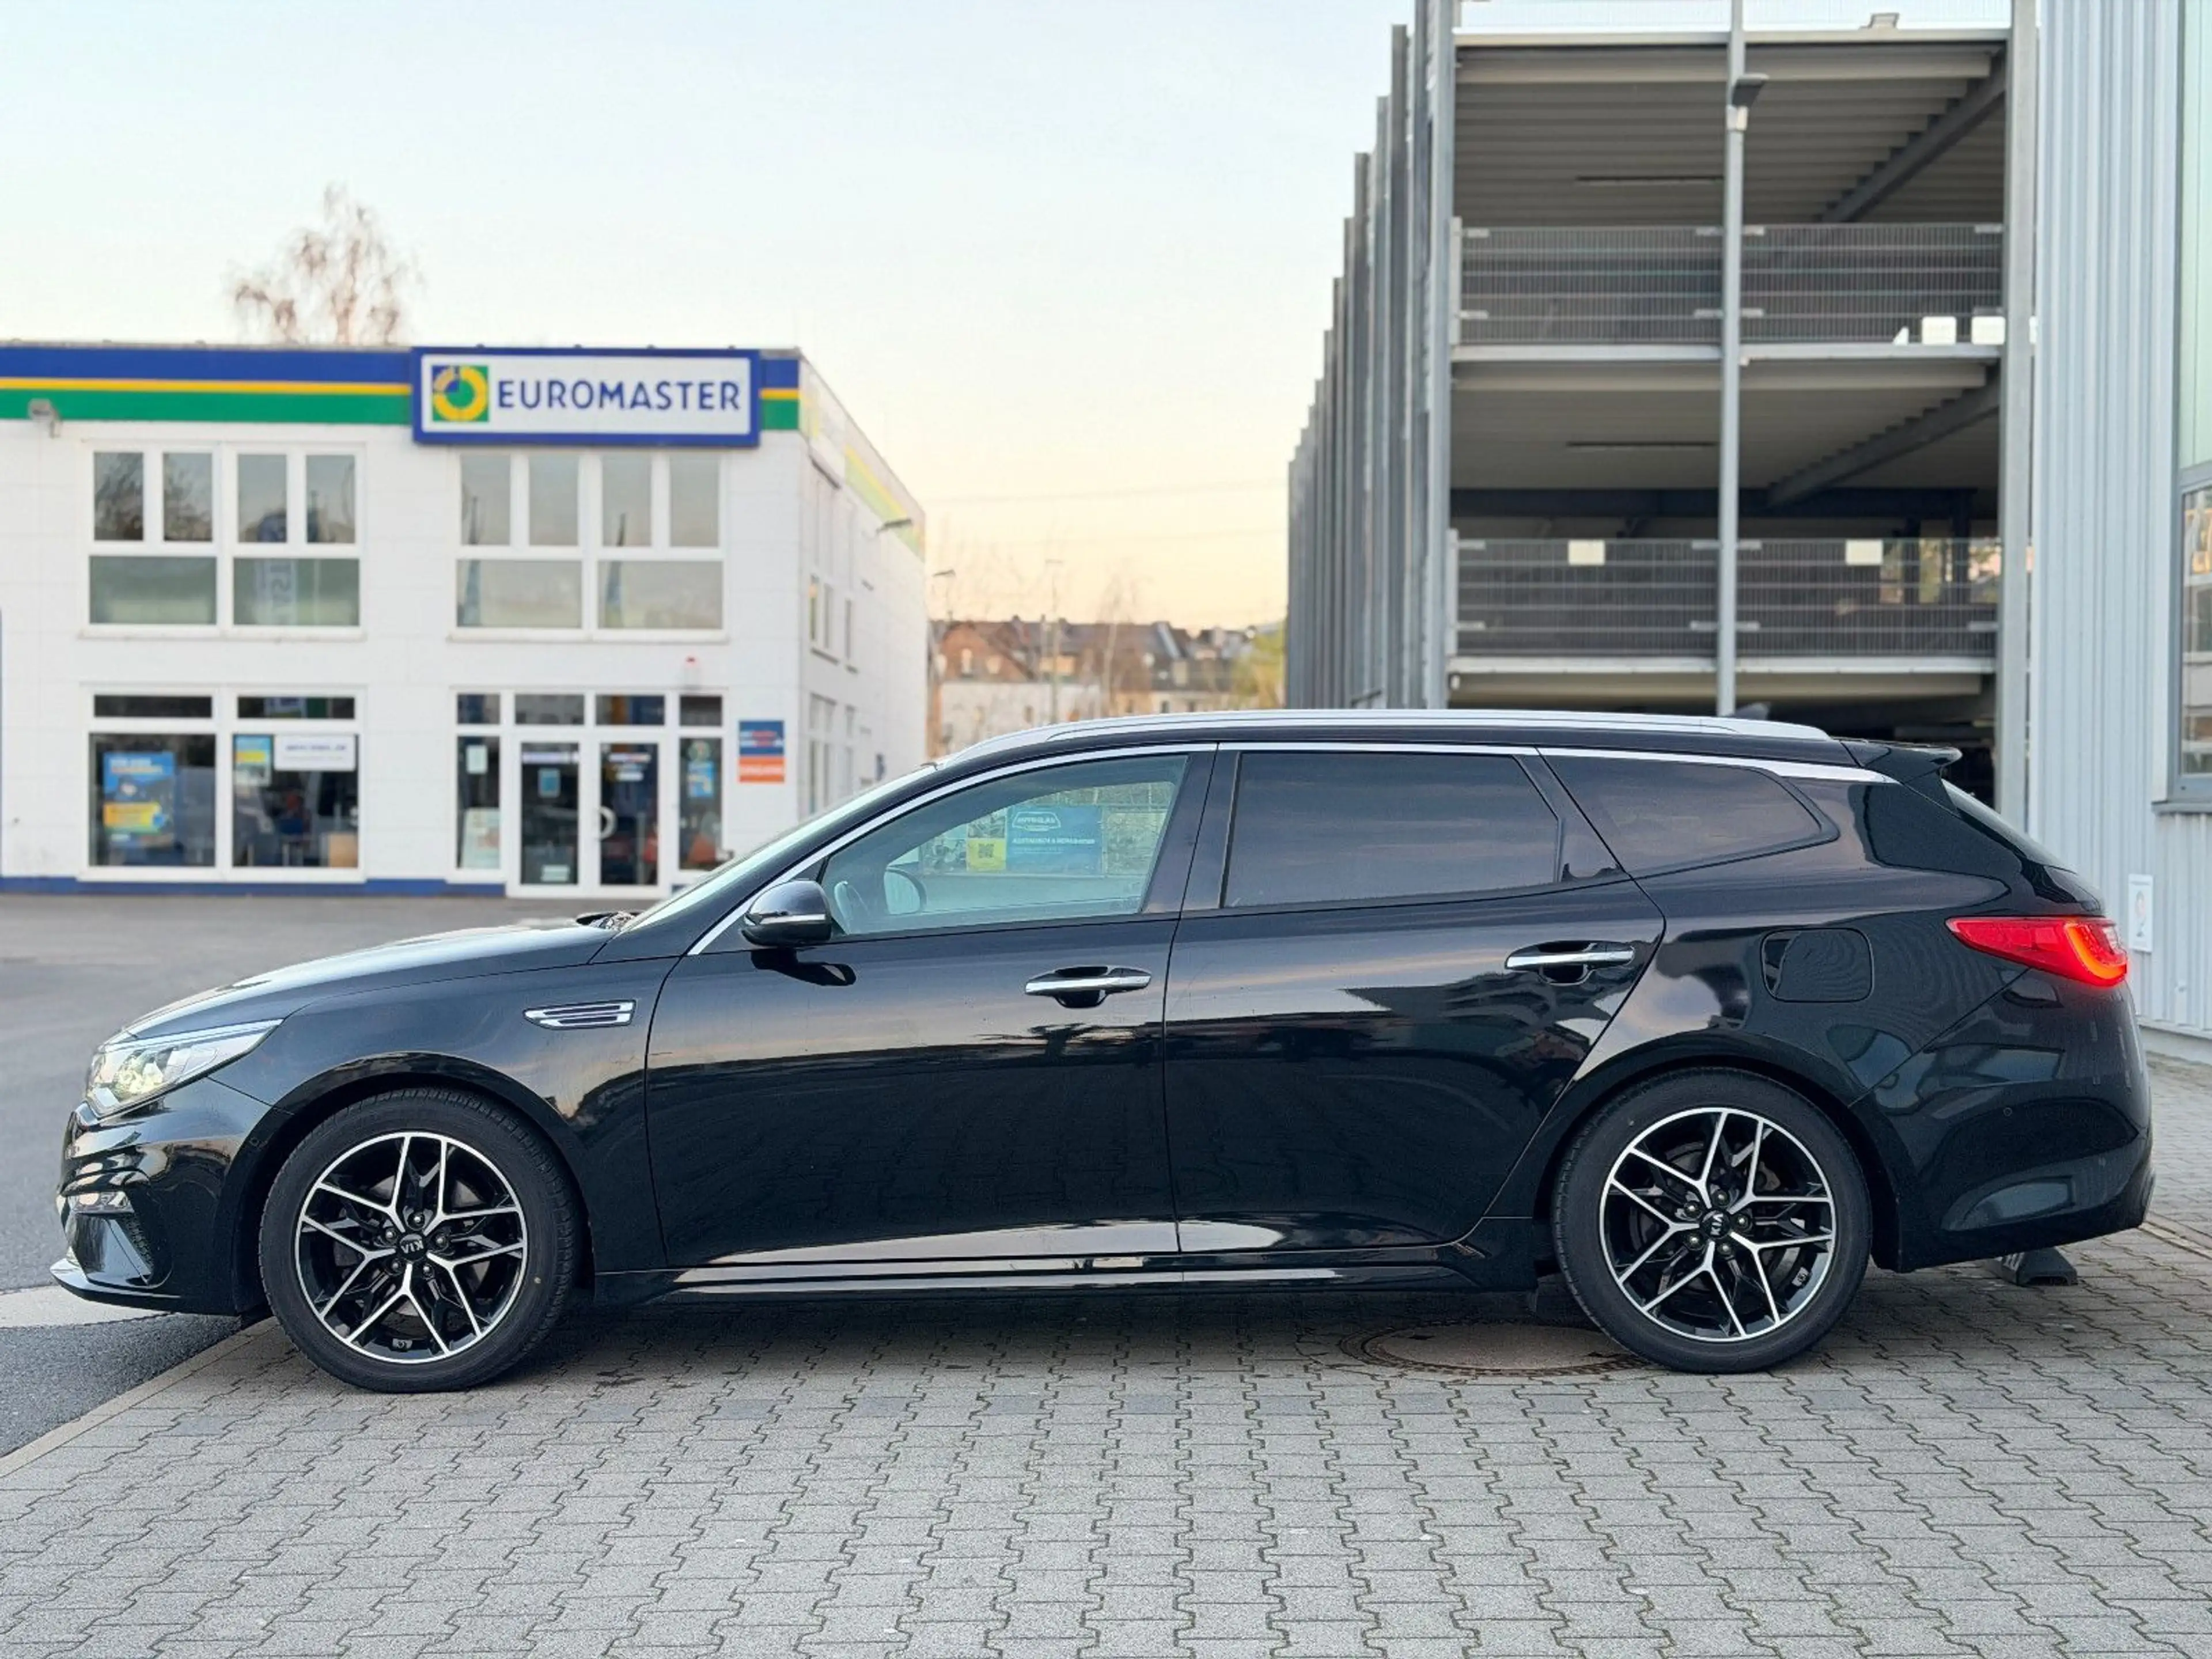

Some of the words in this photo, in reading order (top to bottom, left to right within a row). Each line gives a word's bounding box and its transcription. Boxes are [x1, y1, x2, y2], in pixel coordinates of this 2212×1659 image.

[498, 380, 740, 410] EUROMASTER
[1710, 1213, 1724, 1236] KIA
[400, 1240, 424, 1254] KIA
